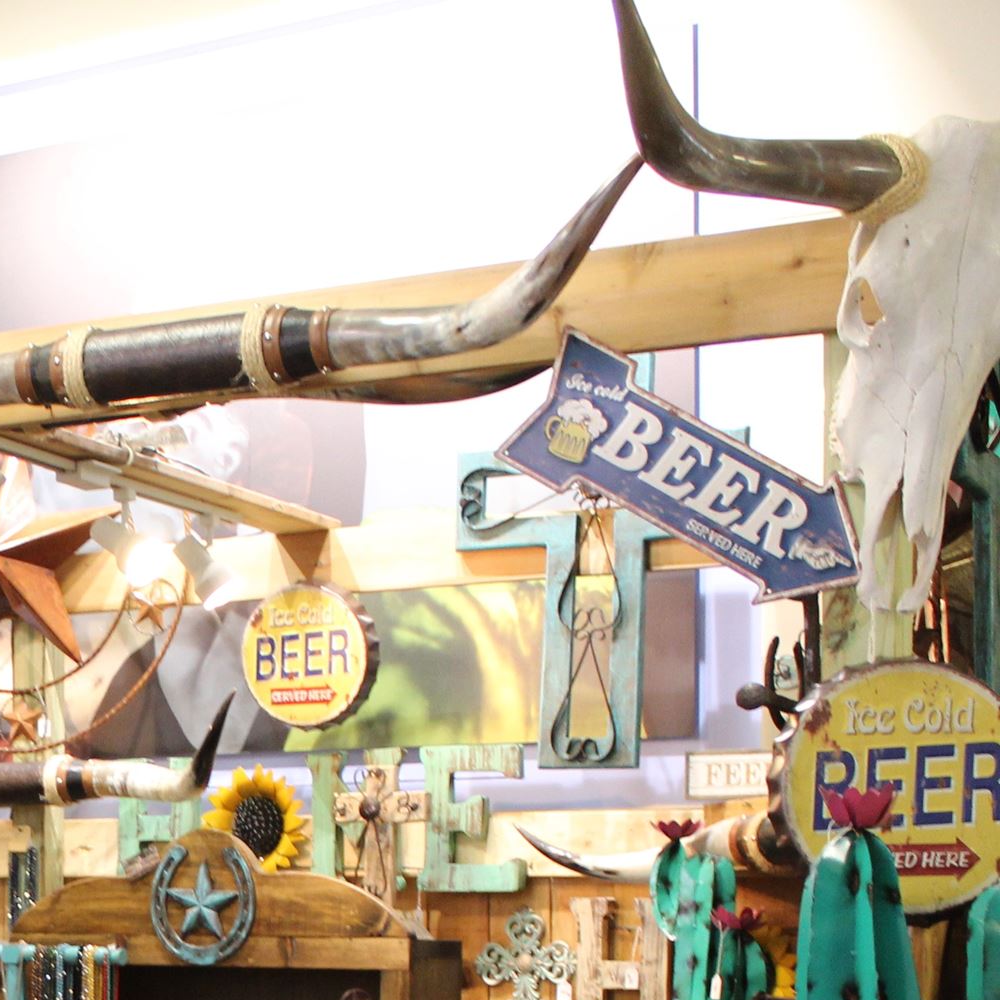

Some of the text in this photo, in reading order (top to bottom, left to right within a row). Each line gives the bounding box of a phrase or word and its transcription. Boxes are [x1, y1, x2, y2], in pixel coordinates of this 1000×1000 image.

[565, 373, 628, 402] Ice cold
[592, 401, 809, 559] BEER
[686, 518, 763, 570] SERVED HERE
[269, 603, 333, 627] Ice Cold
[256, 629, 349, 682] BEER
[271, 688, 333, 703] SERVED HERE
[846, 696, 977, 736] Ice Cold
[813, 741, 1000, 832] BEER
[921, 850, 971, 869] HERE
